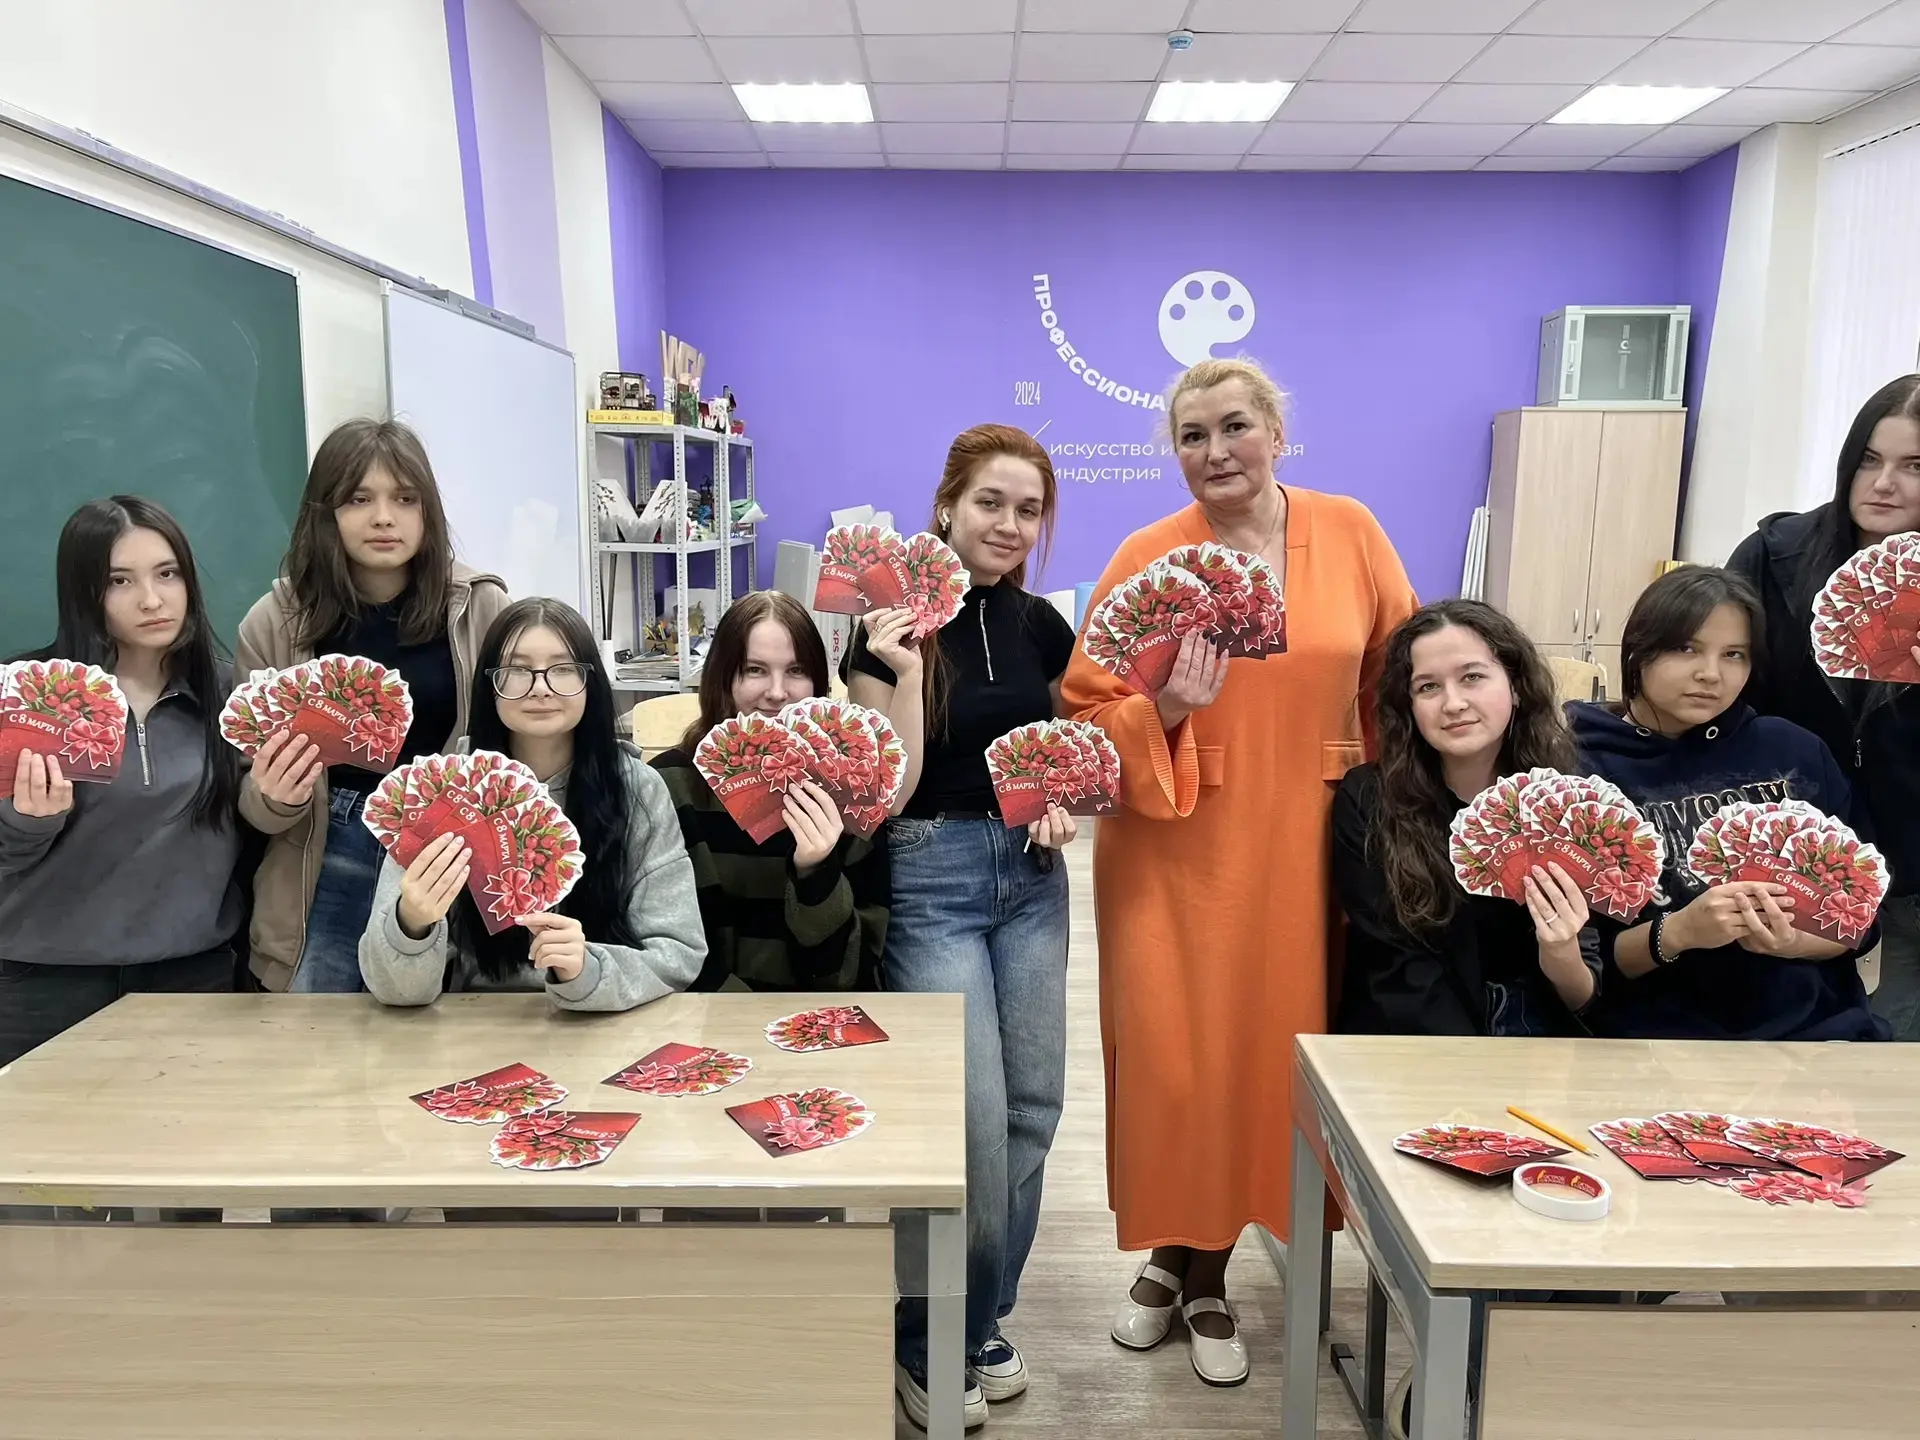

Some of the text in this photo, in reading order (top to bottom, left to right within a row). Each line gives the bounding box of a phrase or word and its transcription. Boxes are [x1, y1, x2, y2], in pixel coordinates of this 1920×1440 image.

[1033, 273, 1167, 412] ПРОФЕССИОНА
[1015, 381, 1041, 406] 2024
[1050, 443, 1173, 460] искусство и
[1053, 468, 1161, 484] индустрия
[891, 561, 901, 569] 8
[830, 567, 837, 576] 8
[836, 570, 858, 583] МАРТ
[1861, 613, 1870, 623] 8
[832, 628, 840, 653] XPS
[1136, 642, 1144, 652] 8
[1123, 661, 1132, 669] 8
[315, 699, 324, 709] 8
[18, 713, 28, 724] 8
[725, 782, 734, 792] 8
[1005, 782, 1012, 792] 8
[453, 794, 464, 803] 8
[465, 811, 476, 821] 8
[496, 824, 508, 833] 8
[1508, 840, 1517, 851] 8
[1560, 844, 1571, 853] 8
[1761, 857, 1771, 867] 8
[1782, 874, 1792, 884] 8
